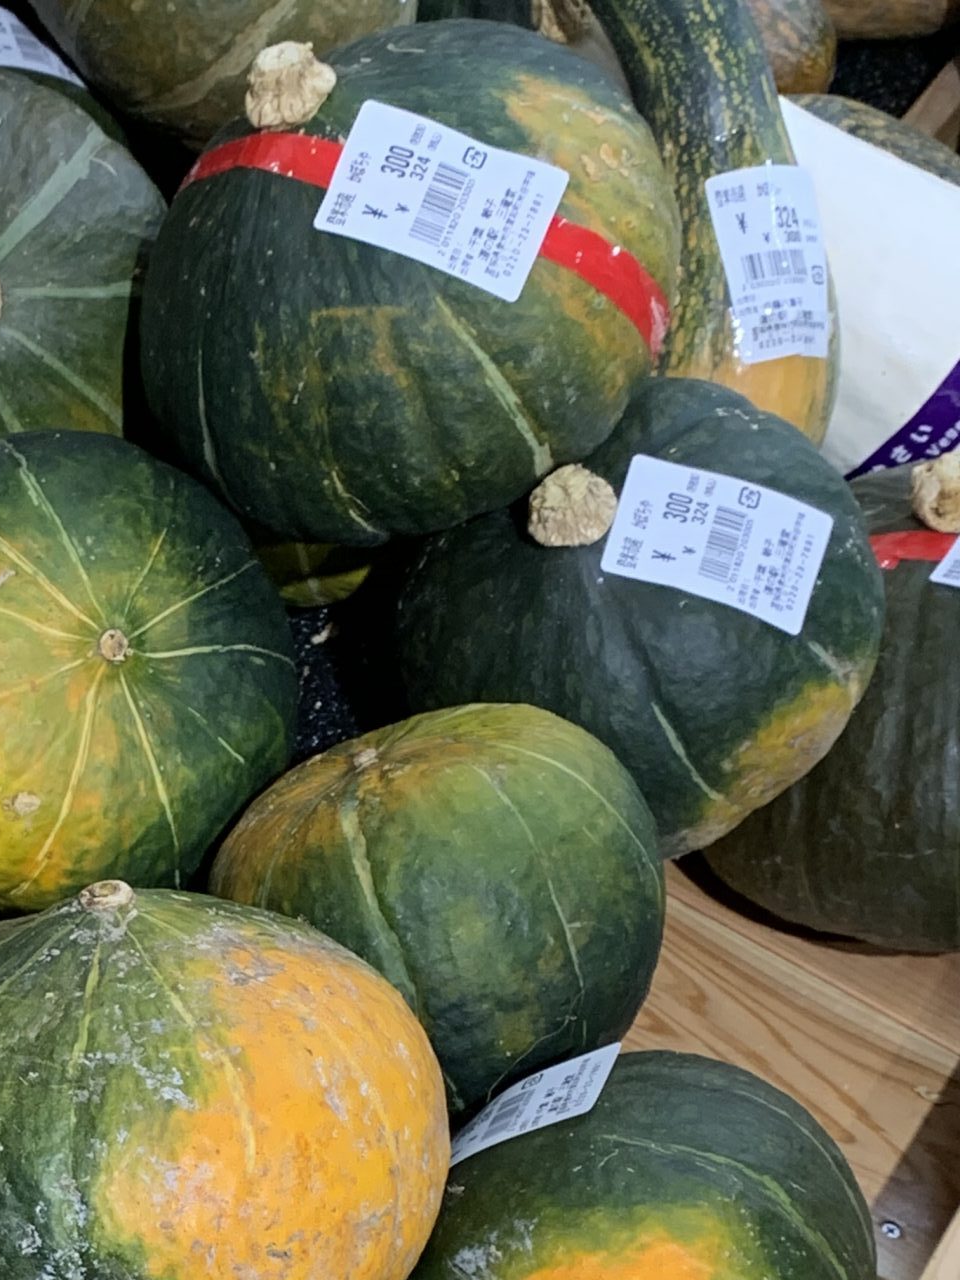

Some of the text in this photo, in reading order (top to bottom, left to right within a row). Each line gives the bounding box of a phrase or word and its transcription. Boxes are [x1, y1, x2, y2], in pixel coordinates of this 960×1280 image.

[381, 145, 414, 179] 300
[410, 156, 431, 181] 324
[775, 206, 799, 228] 324
[663, 492, 693, 523] 300
[691, 502, 709, 525] 324
